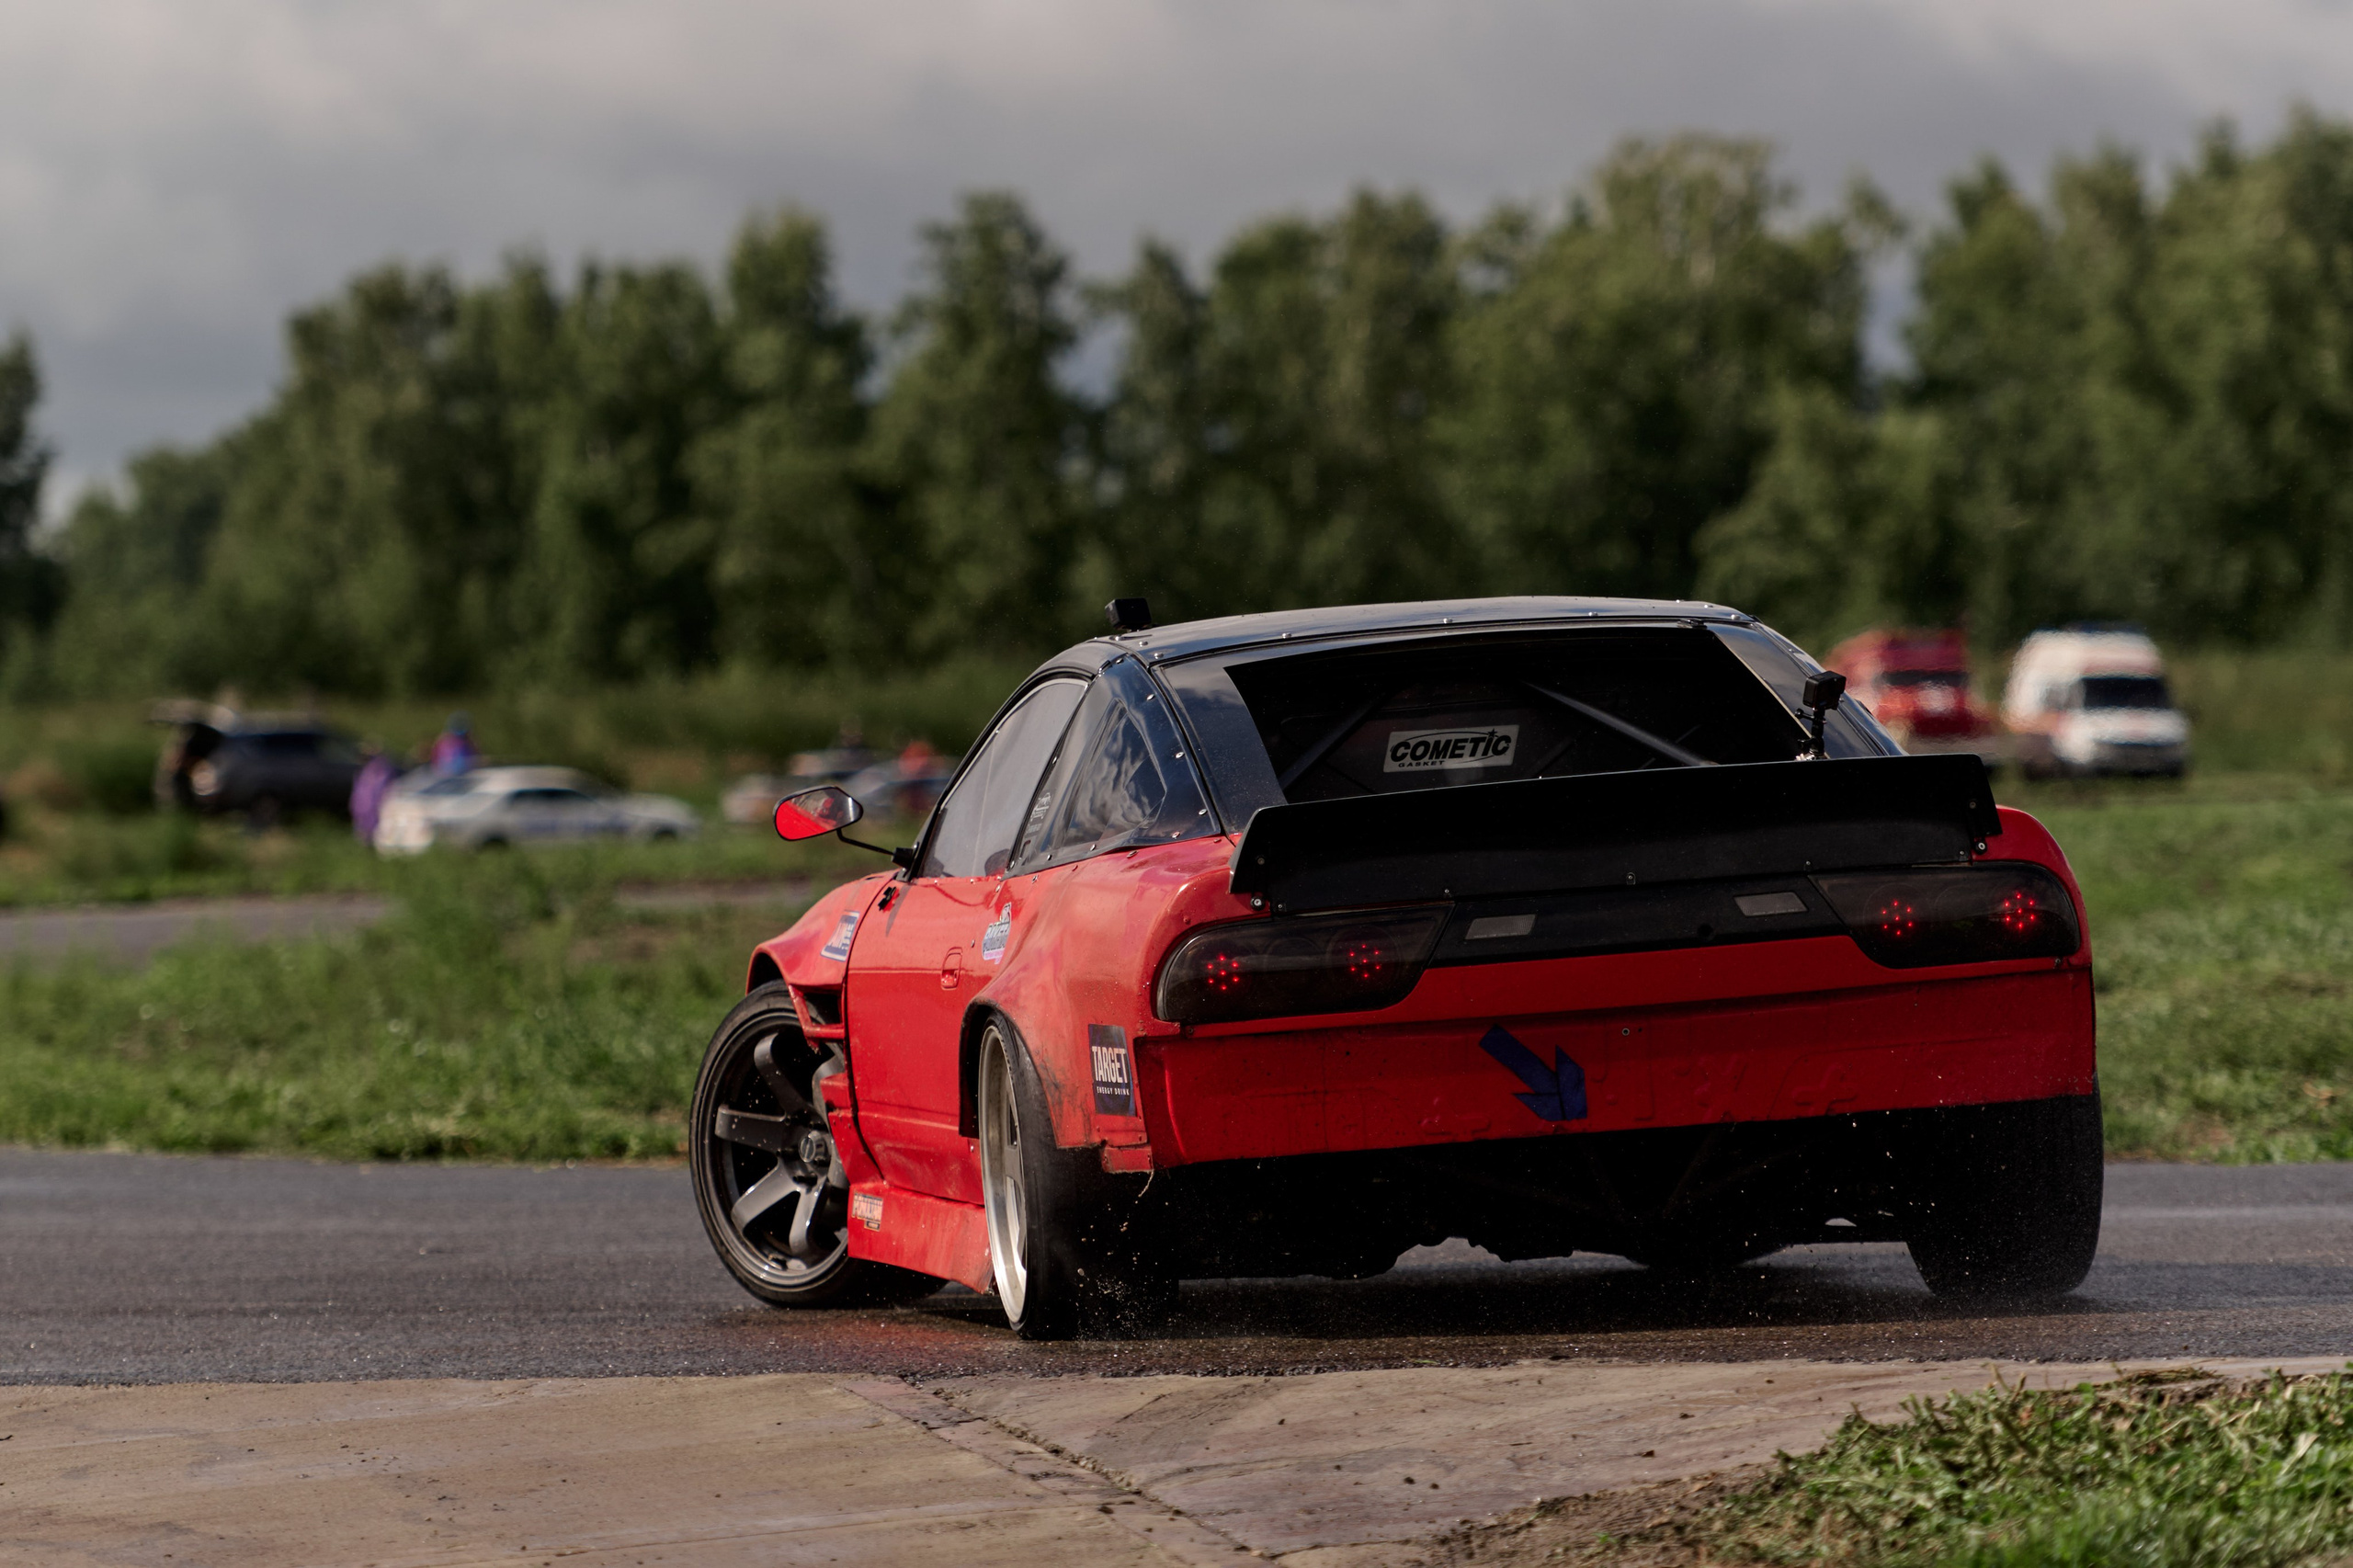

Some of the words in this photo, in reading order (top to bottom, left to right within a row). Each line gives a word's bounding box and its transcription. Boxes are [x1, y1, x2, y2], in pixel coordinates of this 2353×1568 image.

[1391, 734, 1511, 762] COMETIC
[1092, 1046, 1128, 1083] TARGET
[1097, 1086, 1113, 1095] ENERGY
